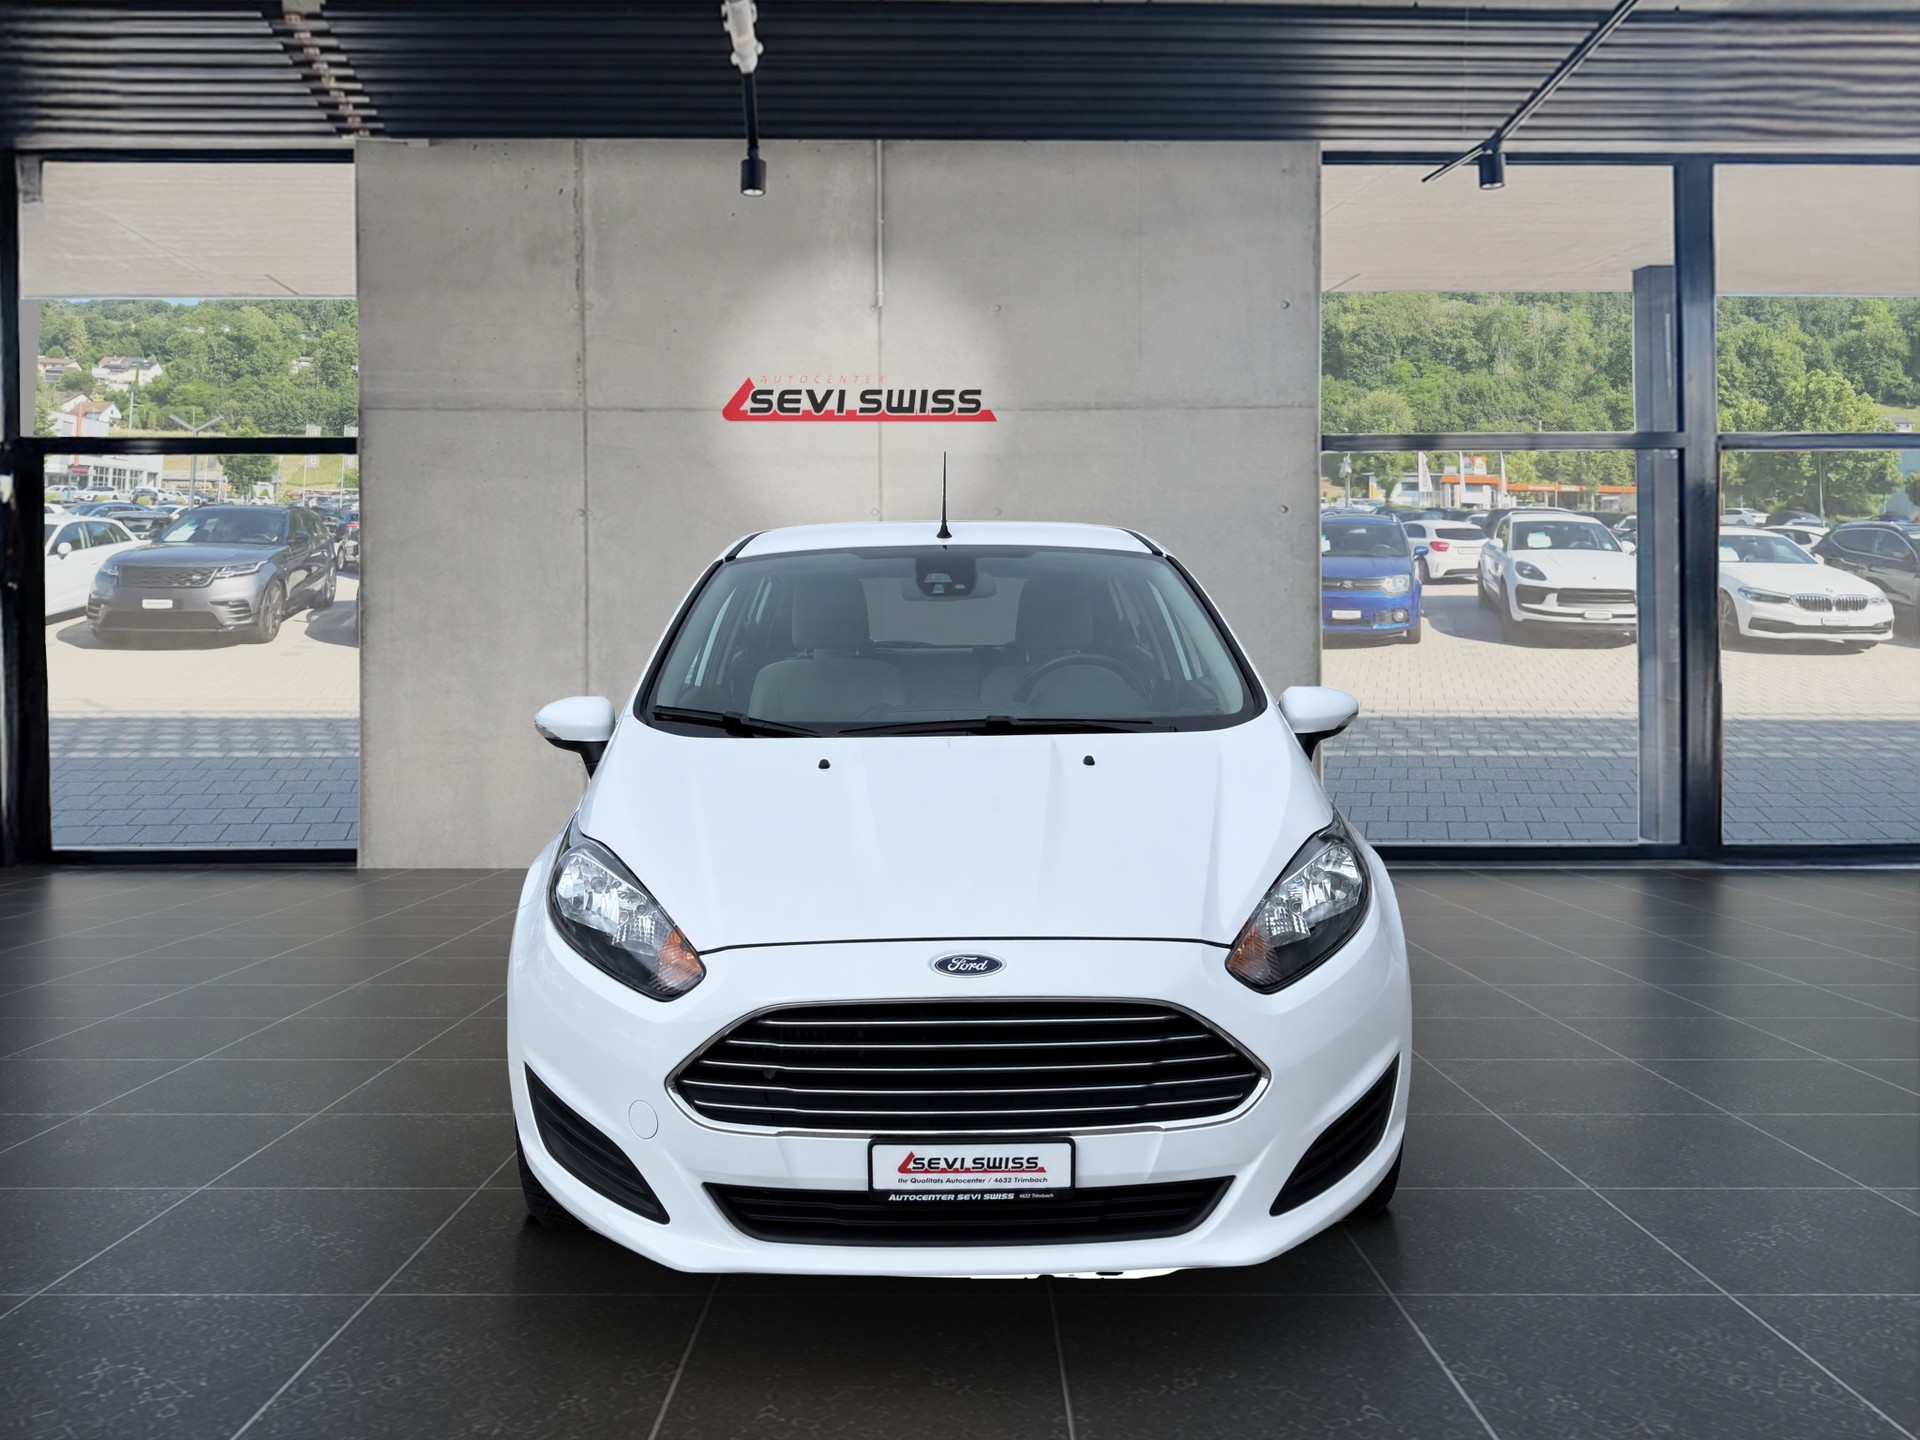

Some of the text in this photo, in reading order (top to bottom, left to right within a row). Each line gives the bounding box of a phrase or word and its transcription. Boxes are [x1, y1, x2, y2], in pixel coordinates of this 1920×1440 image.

[759, 375, 886, 385] AUTOCENTER
[748, 389, 983, 414] SEVI SWISS
[947, 956, 989, 971] Ford
[911, 1156, 1040, 1171] SEVI SWISS
[888, 1193, 955, 1201] AUTOCENTER
[956, 1193, 981, 1201] SEVI
[983, 1192, 1015, 1200] SWISS
